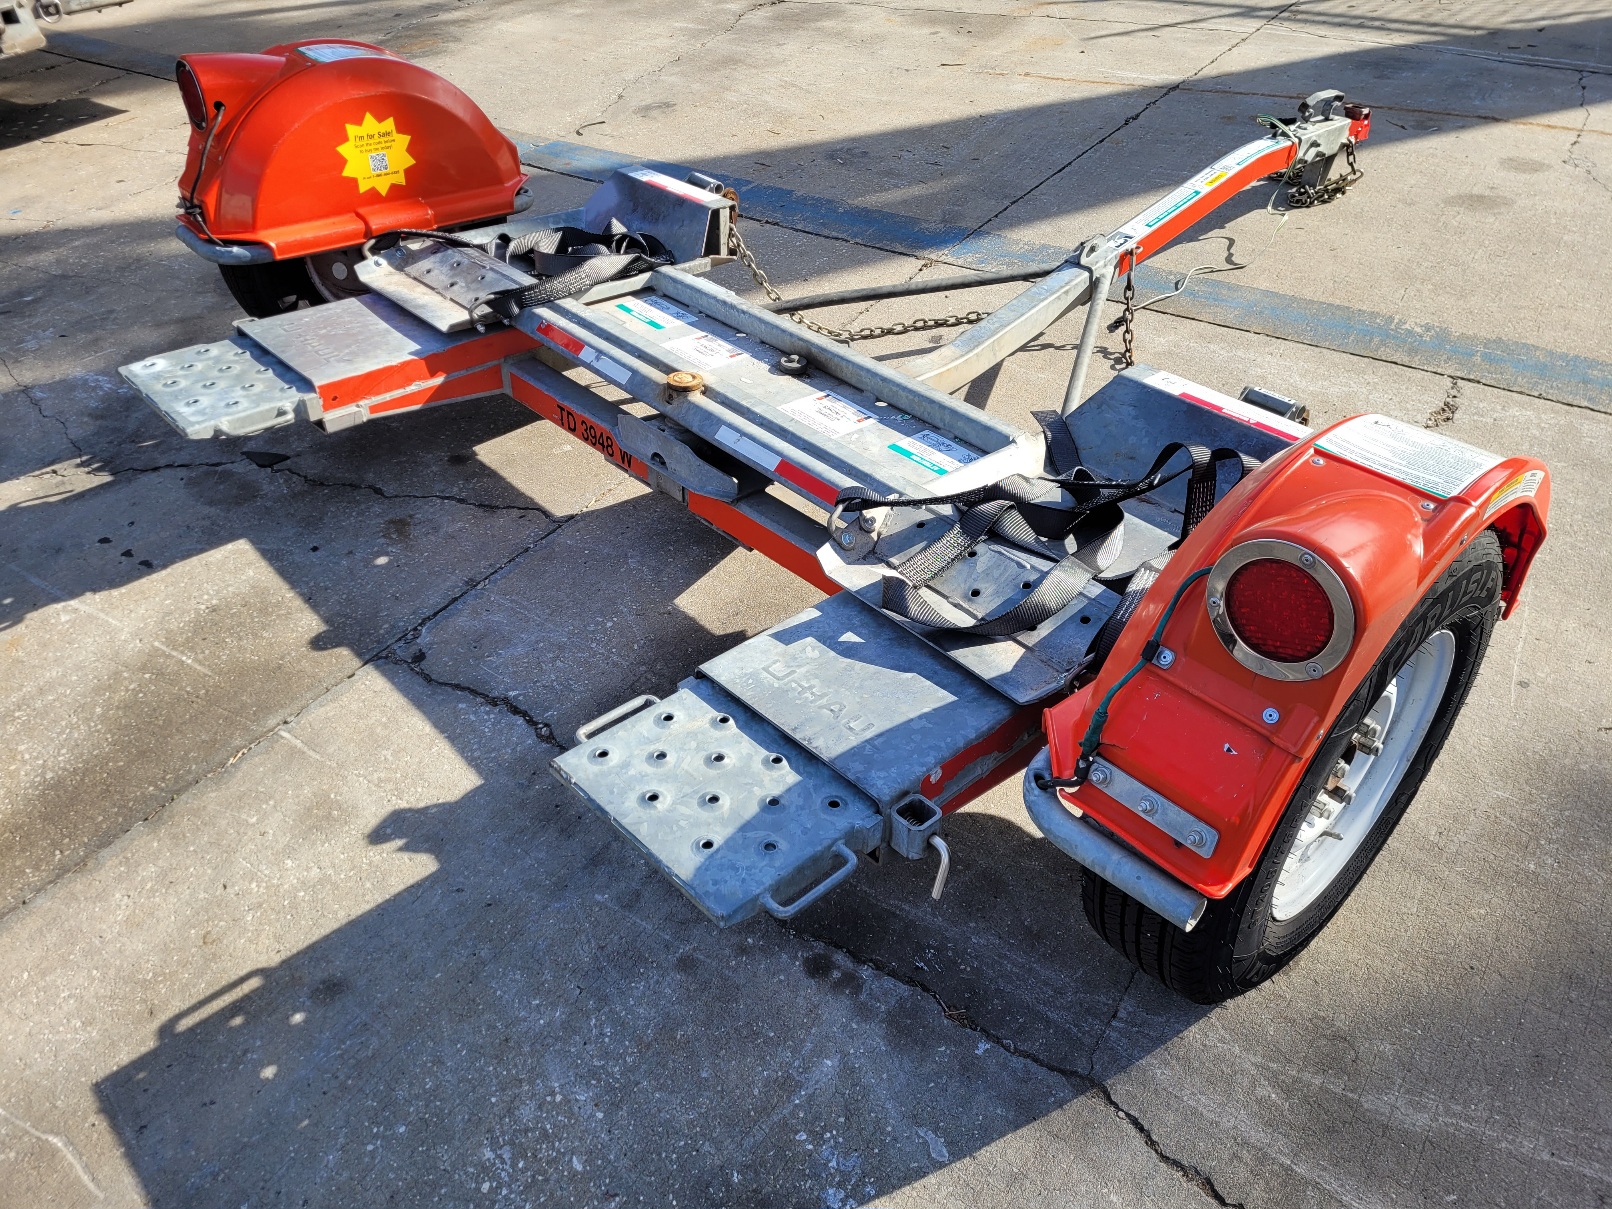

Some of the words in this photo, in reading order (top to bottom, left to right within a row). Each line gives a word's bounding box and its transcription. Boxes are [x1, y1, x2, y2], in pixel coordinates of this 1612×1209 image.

[377, 129, 394, 139] Sale!
[557, 404, 576, 432] TD
[581, 420, 614, 457] 3948
[619, 448, 632, 468] W
[1386, 569, 1498, 682] CARLISLE
